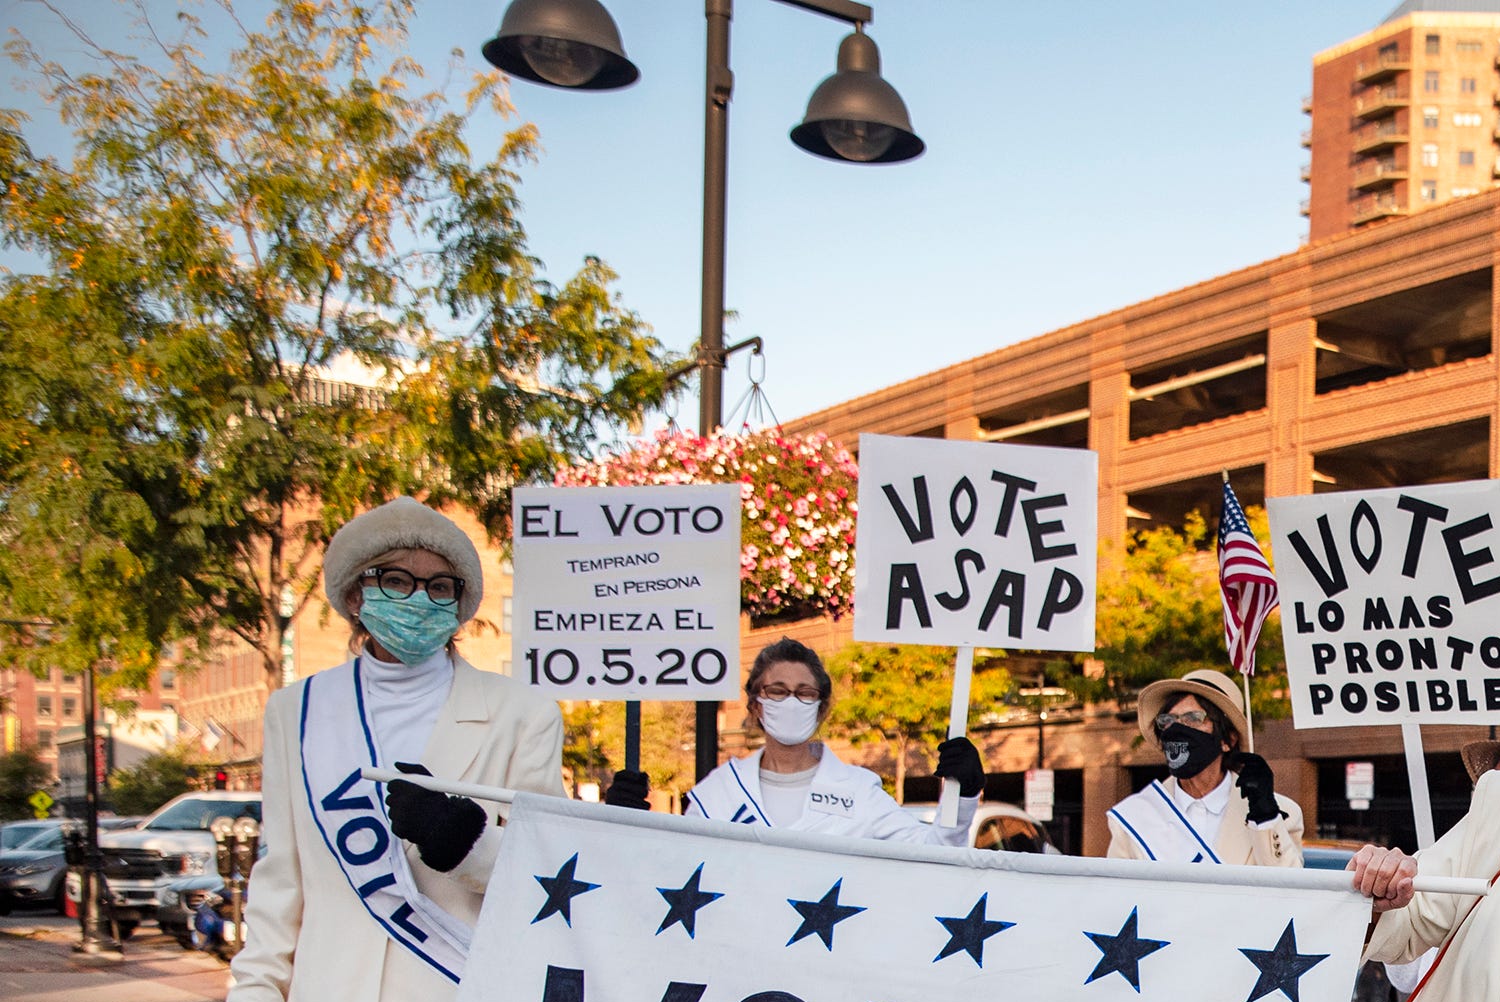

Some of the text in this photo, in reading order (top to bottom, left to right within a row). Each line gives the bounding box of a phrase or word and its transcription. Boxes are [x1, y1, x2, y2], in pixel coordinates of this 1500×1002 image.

[881, 470, 1077, 562] VOTE
[886, 548, 1084, 640] ASAP
[1295, 595, 1454, 634] LO MAS
[525, 647, 728, 685] 10.5.20
